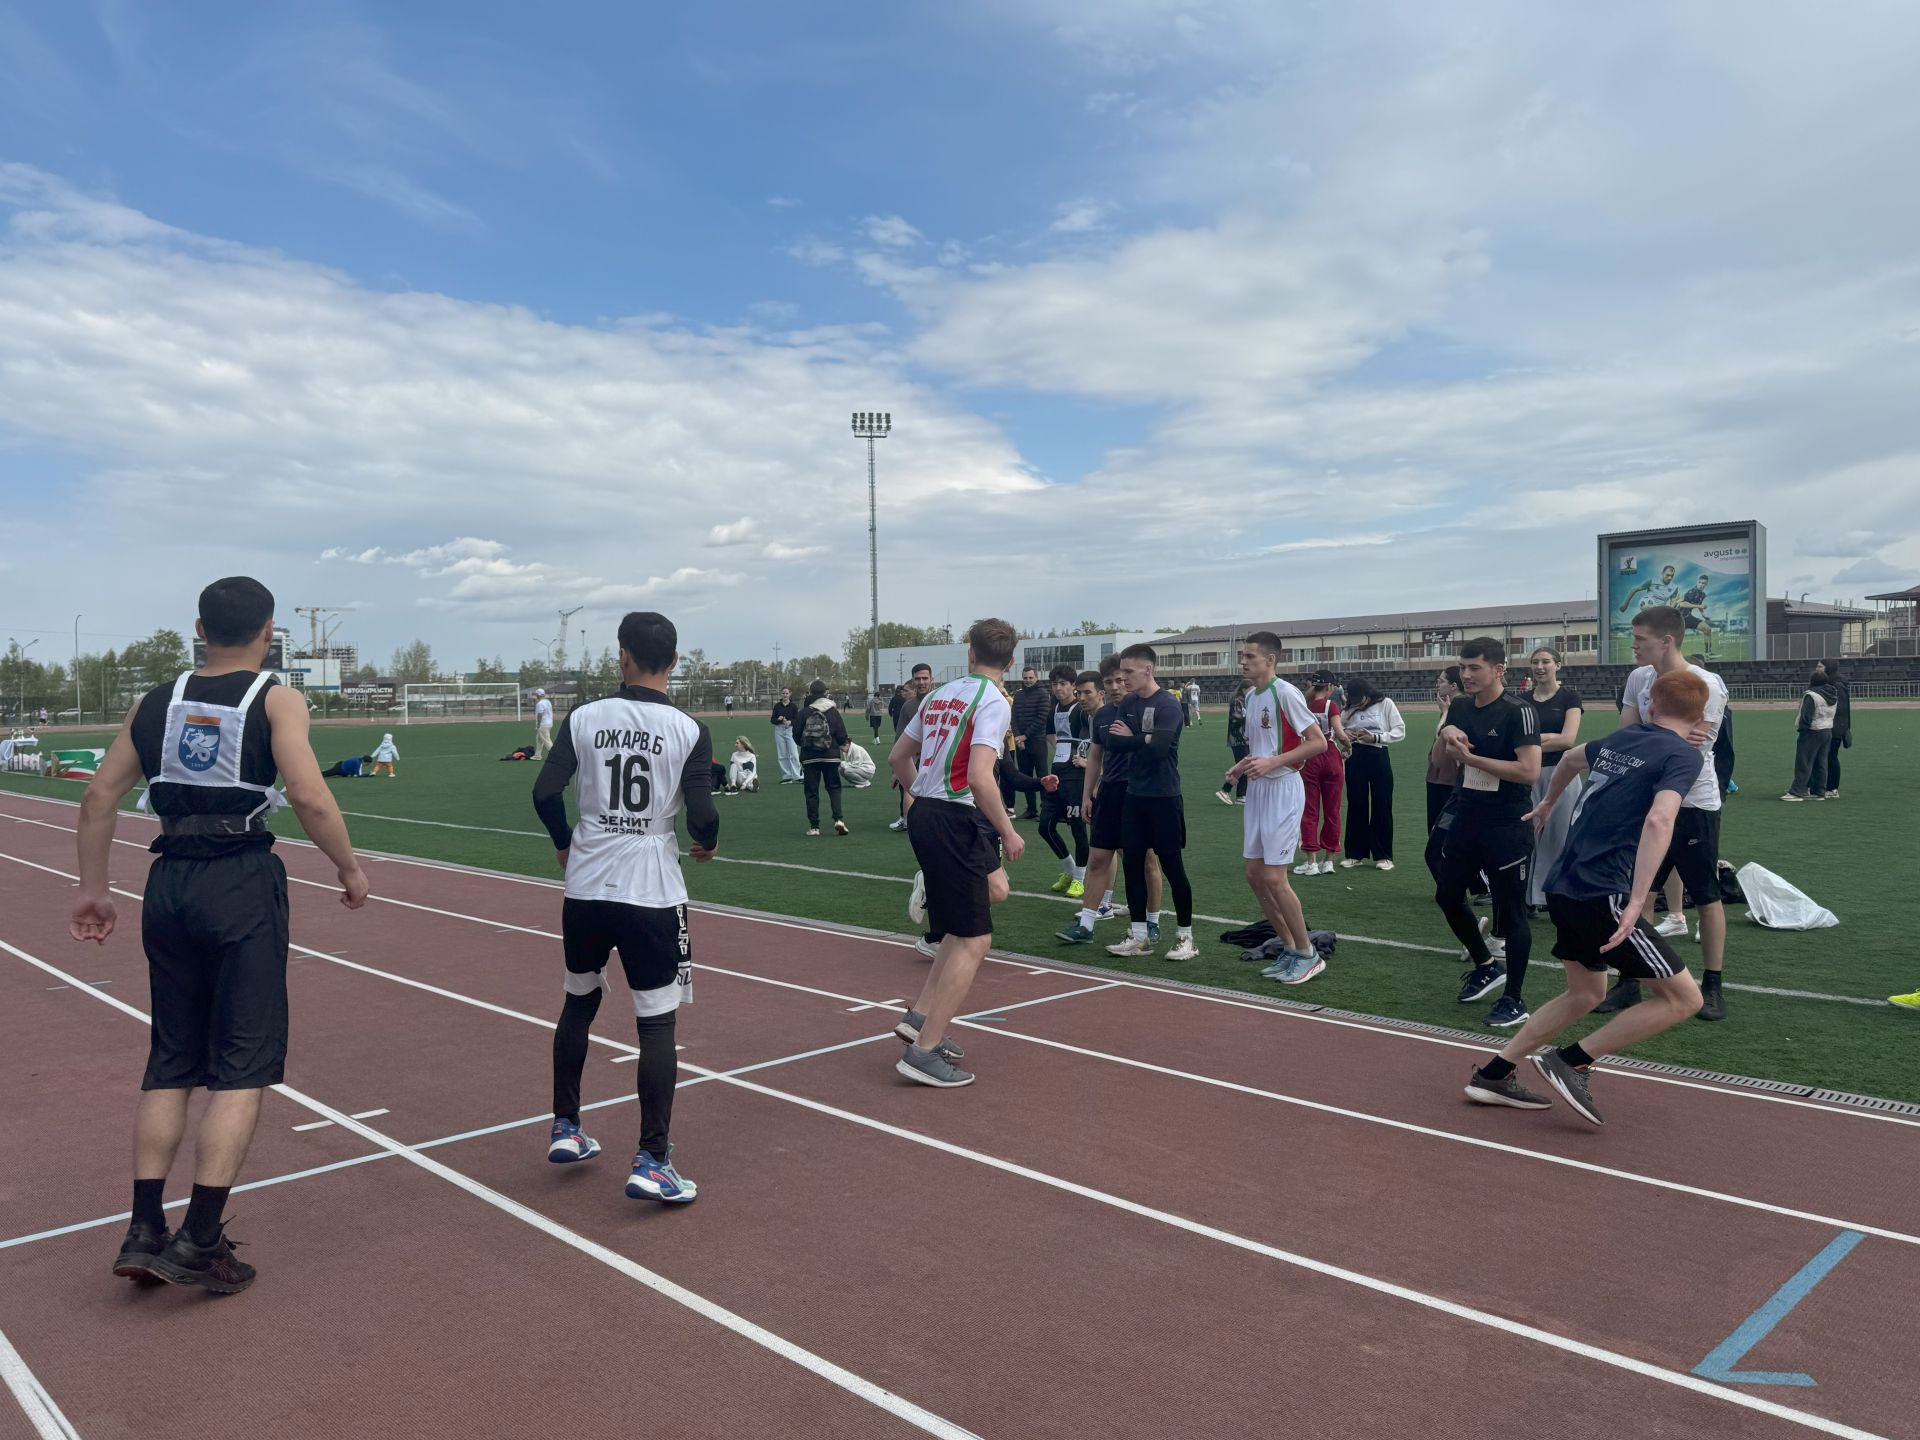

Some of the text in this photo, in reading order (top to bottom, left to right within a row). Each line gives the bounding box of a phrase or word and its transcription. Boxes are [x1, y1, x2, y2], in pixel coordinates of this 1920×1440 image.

[1703, 549, 1733, 559] avgust
[594, 729, 664, 755] ОЖАРВ.Б
[604, 753, 650, 812] 16
[1066, 805, 1080, 818] 24
[598, 814, 653, 828] ЗЕНИТ
[604, 826, 646, 836] КАЗАНЬ
